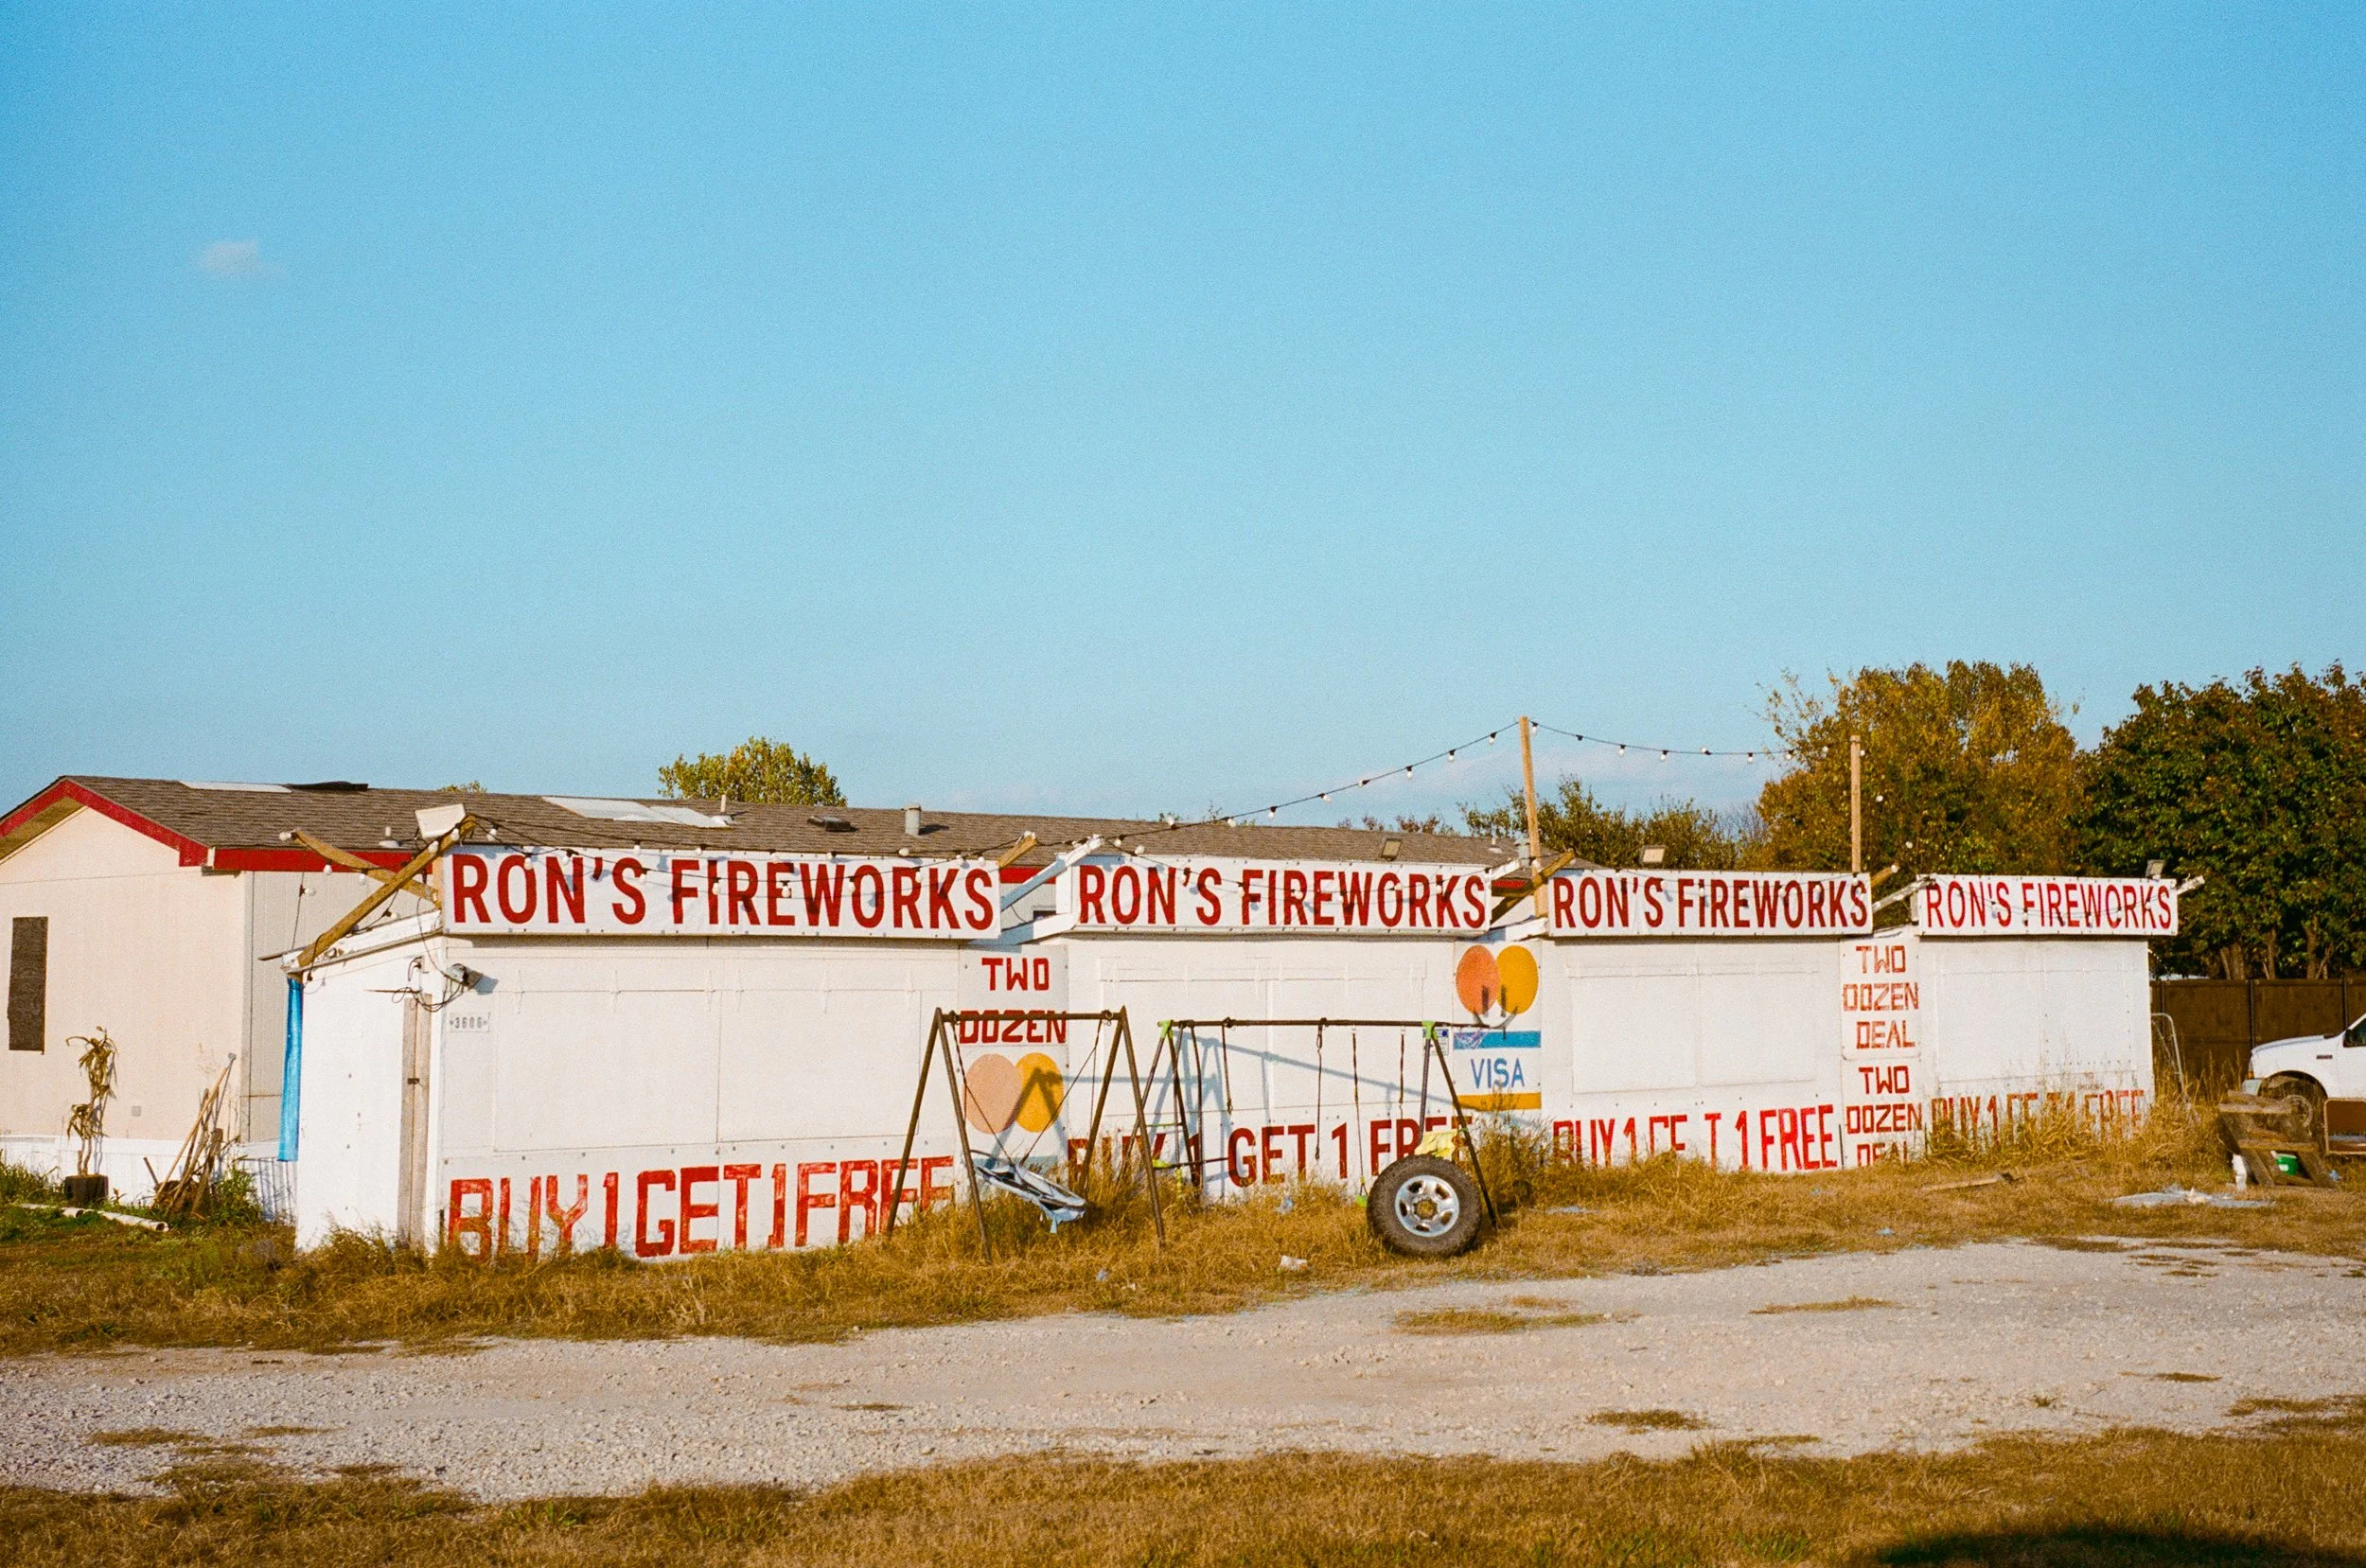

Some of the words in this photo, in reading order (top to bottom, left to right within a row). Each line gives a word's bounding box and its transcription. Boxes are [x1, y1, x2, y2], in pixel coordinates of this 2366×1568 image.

[452, 854, 647, 925] RON'S
[671, 858, 994, 930] FIREWORKS
[1079, 865, 1221, 925] RON'S
[1242, 869, 1487, 927] FIREWORKS
[1554, 876, 1664, 928] RON'S
[1678, 879, 1868, 928] FIREWORKS
[1925, 880, 2012, 928] RON'S
[2022, 883, 2172, 929] FIREWORKS
[981, 958, 1050, 991] TWO
[1856, 945, 1906, 974] TWO
[1843, 982, 1919, 1012] DOZEN
[959, 1010, 1067, 1044] DOZEN
[1856, 1020, 1916, 1049] DEAL
[1470, 1057, 1525, 1089] VISA
[1858, 1066, 1910, 1094] TWO
[1846, 1102, 1923, 1134] DOZEN
[1227, 1124, 1315, 1188] GET
[1331, 1121, 1348, 1179] 1
[1735, 1110, 1750, 1169] 1
[1759, 1103, 1838, 1172] FREE
[447, 1174, 588, 1263] BUY
[635, 1164, 761, 1257] GET
